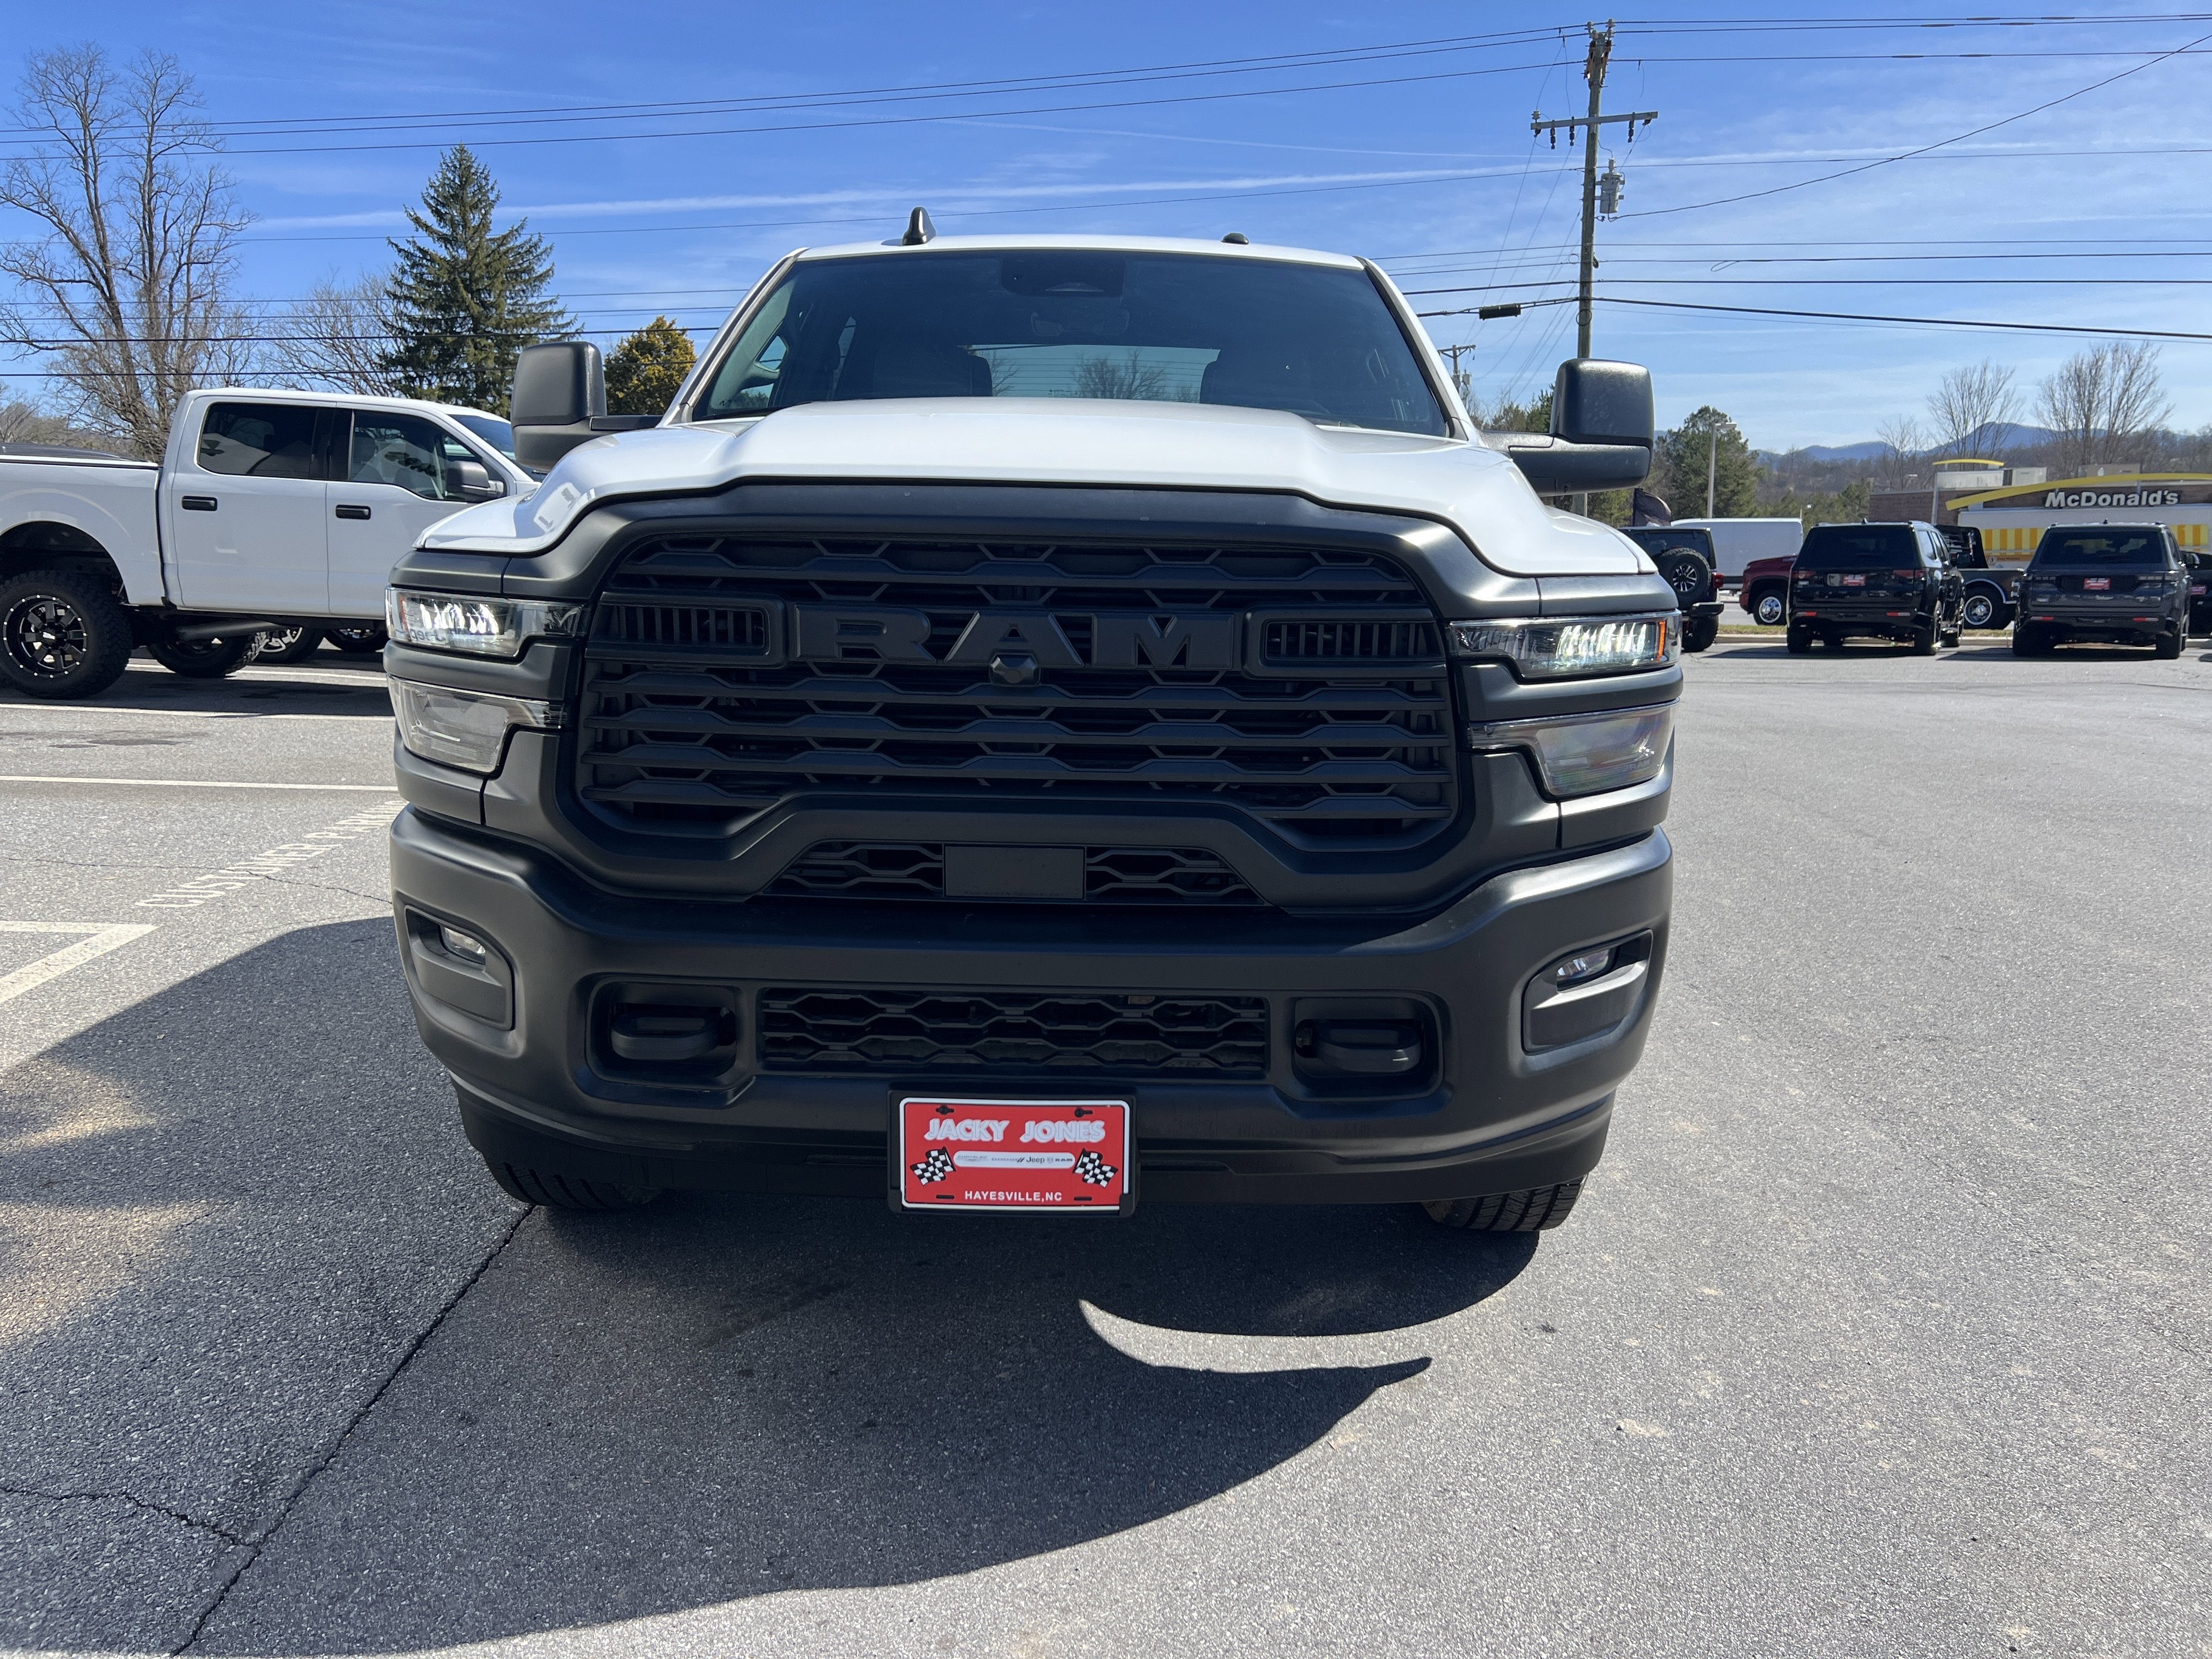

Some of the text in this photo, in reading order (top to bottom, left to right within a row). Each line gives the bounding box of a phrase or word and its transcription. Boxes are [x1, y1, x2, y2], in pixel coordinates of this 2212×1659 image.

[2045, 489, 2179, 507] McDonald's
[793, 604, 1234, 670] RAM
[924, 1118, 1105, 1143] JACKY JONES
[1026, 1156, 1045, 1164] Jeep
